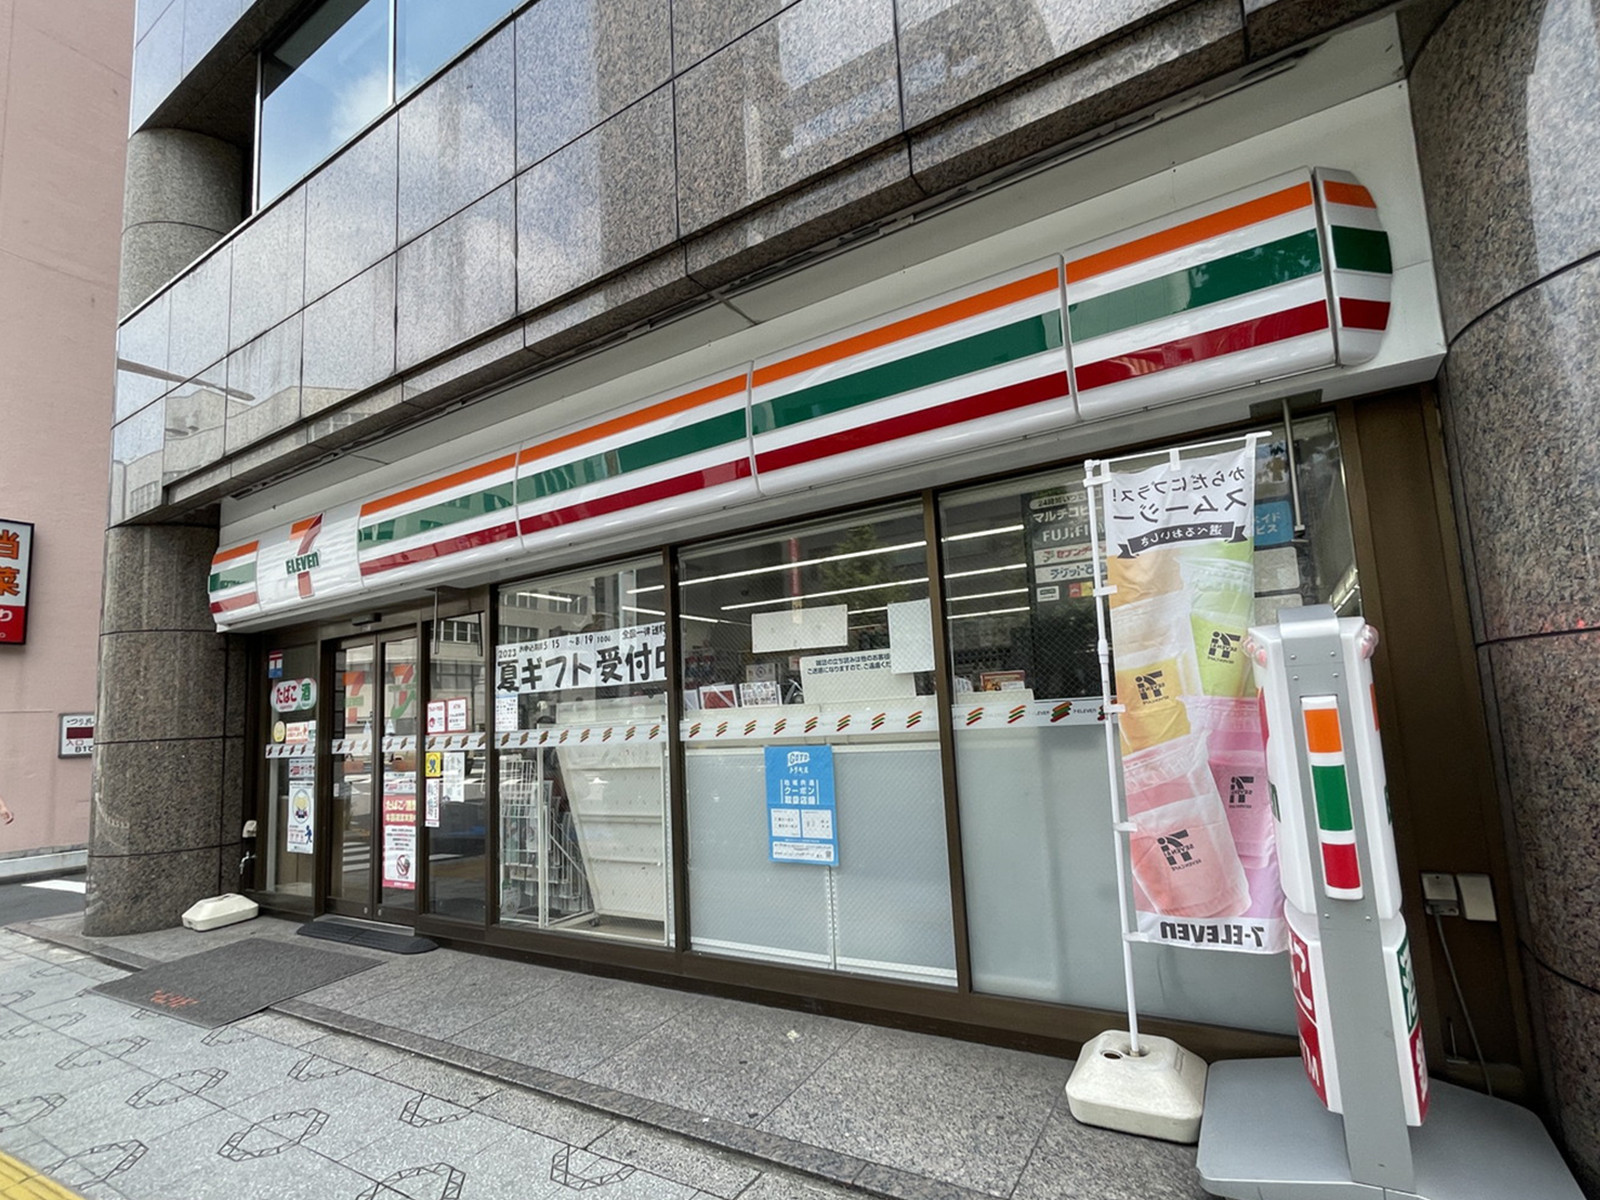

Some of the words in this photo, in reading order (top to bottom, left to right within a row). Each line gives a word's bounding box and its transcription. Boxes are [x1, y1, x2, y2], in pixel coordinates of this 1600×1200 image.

[498, 648, 517, 659] 2023
[497, 642, 667, 693] 夏ギフト受付中
[276, 685, 298, 704] たばこ
[301, 683, 311, 701] 酒
[784, 787, 815, 795] クーポン
